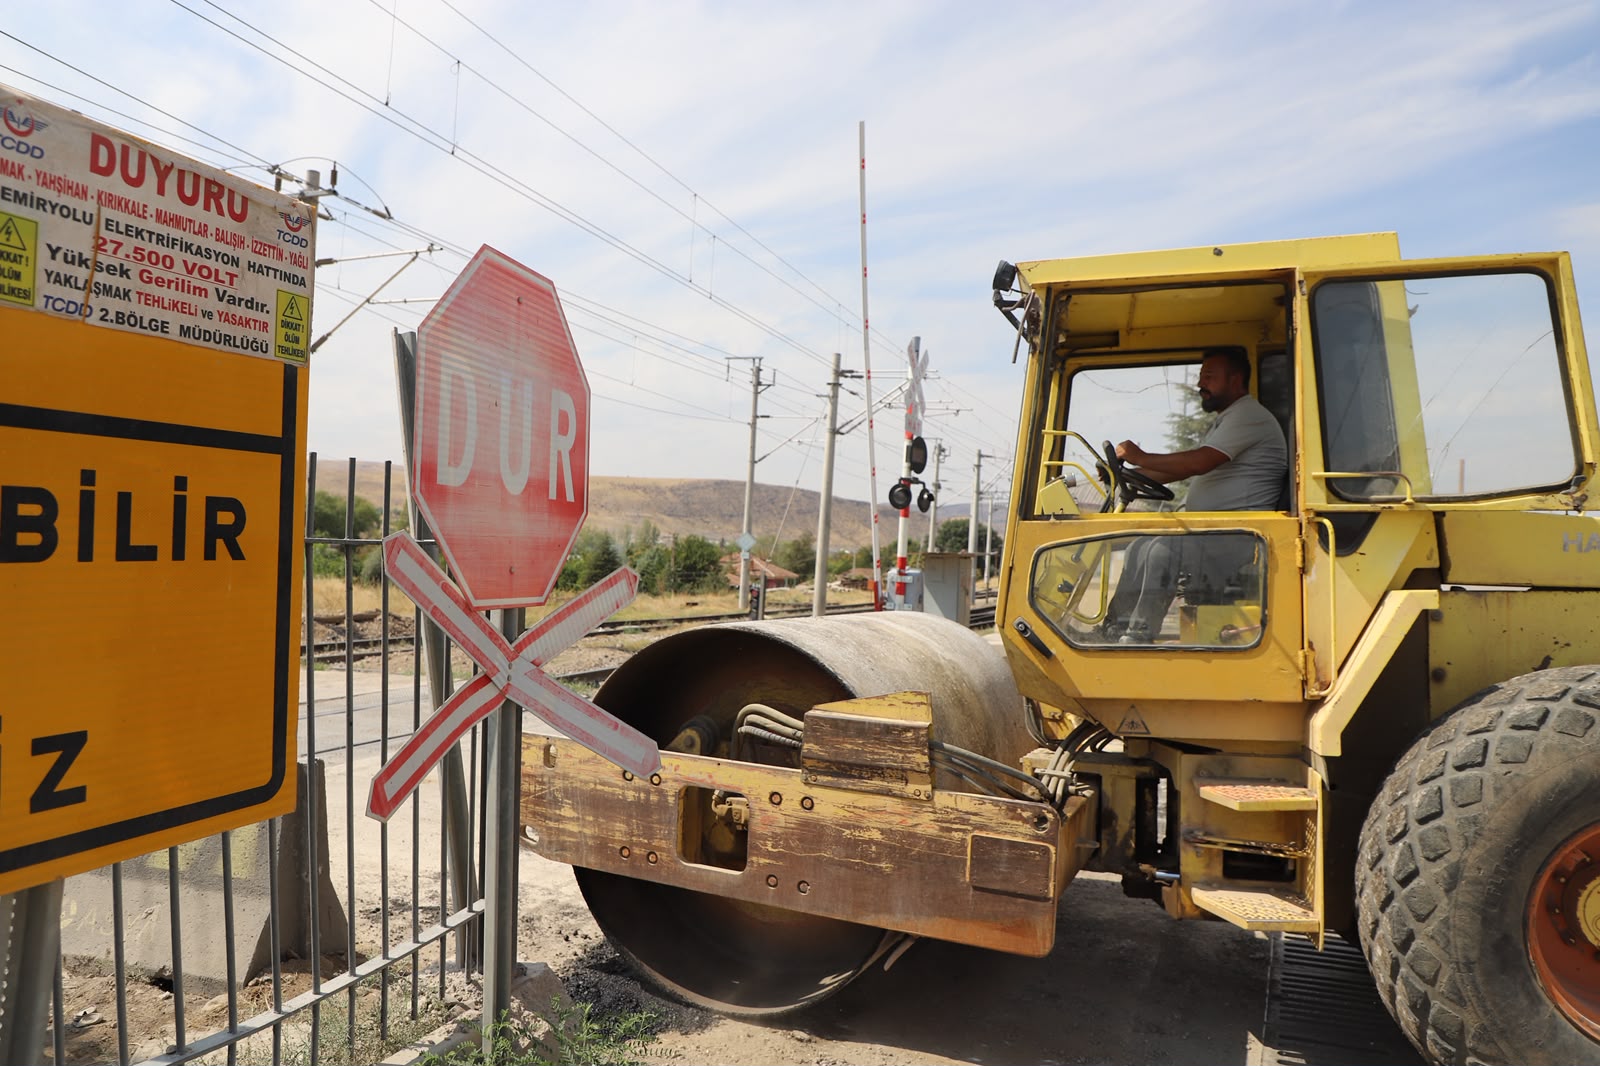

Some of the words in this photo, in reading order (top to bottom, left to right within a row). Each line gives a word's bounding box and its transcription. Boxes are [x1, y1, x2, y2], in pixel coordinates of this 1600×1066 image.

[0, 133, 45, 160] CDD
[89, 132, 249, 223] DUYURU
[1, 185, 93, 225] EMİRYOLU
[105, 217, 240, 268] ELEKTRİFİKASYON
[248, 260, 306, 288] HATTINDA
[35, 169, 88, 202] YAHŞİHAN
[97, 189, 148, 220] KIRIKKALE
[155, 208, 209, 239] MAHMUTLAR
[251, 236, 284, 262] İZZETTİN
[289, 251, 309, 270] YAĞLI
[277, 229, 308, 249] TCDD
[46, 243, 132, 280] Yüksek
[139, 269, 209, 299] Gerilim
[215, 287, 270, 315] Vardır.
[92, 236, 175, 270] 27.500
[183, 259, 239, 287] VOLT
[43, 295, 93, 318] TCDD
[99, 308, 170, 334] 2.BÖLGE
[179, 324, 269, 354] MÜDÜRLÜĞÜ
[44, 269, 132, 302] YAKLAŞMAK
[201, 309, 213, 320] ve
[217, 310, 269, 333] YASAKTIR
[281, 318, 301, 332] DİKKAT
[284, 332, 300, 344] ÖLÜM
[436, 351, 577, 502] DUR
[1, 469, 246, 563] BİLİR
[0, 715, 88, 814] Z
